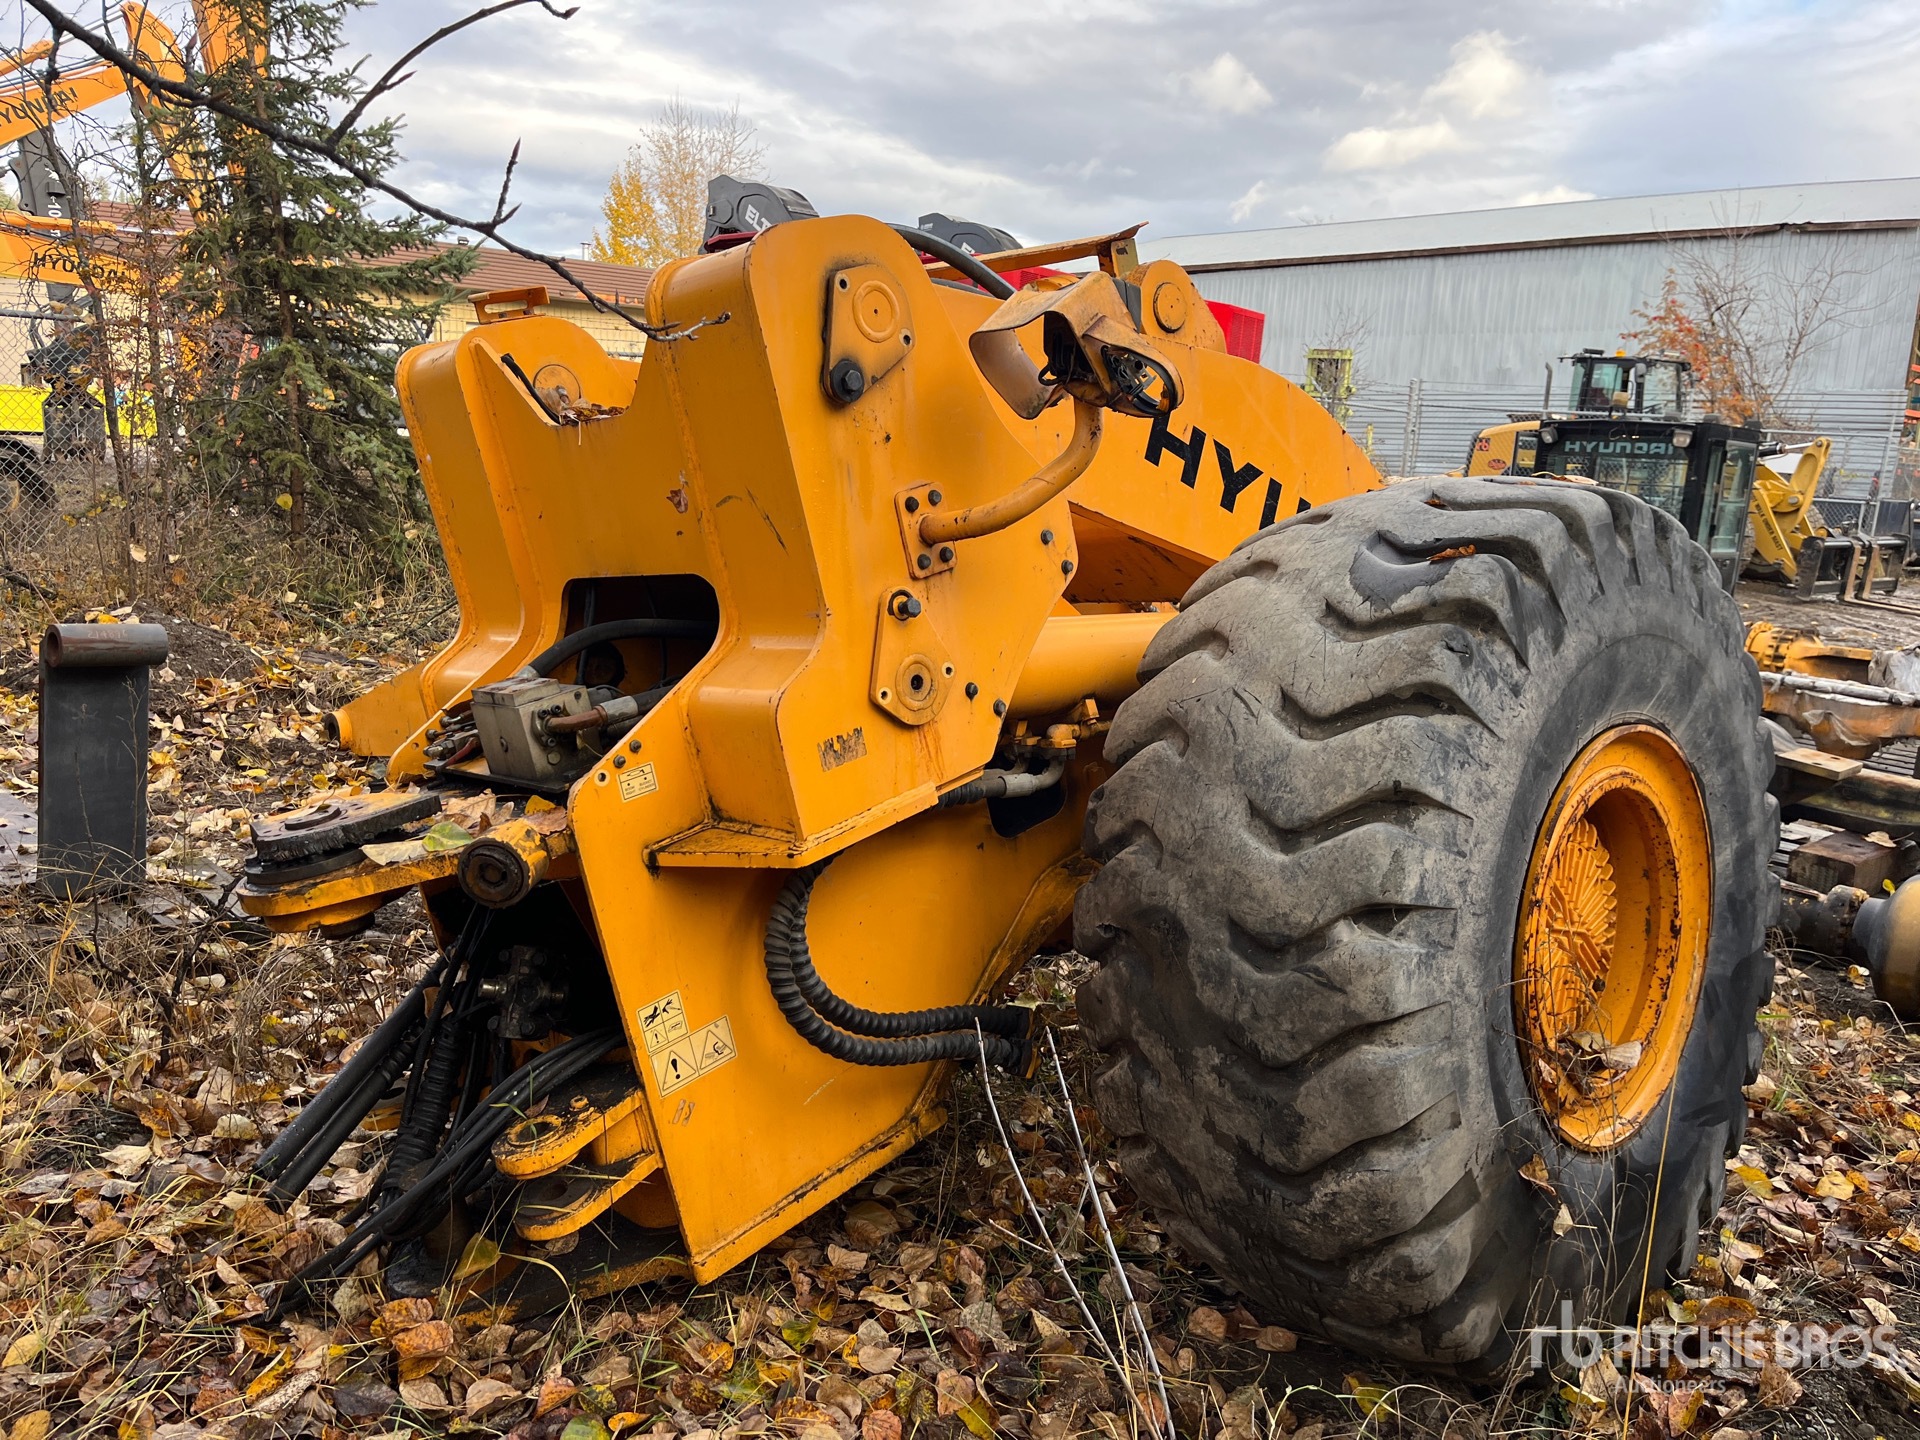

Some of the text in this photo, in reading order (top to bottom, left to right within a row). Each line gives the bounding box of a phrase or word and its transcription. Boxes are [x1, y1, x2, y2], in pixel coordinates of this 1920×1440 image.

[0, 87, 78, 126] YUNAI
[33, 252, 126, 279] HYUDAI
[1564, 441, 1674, 455] HYUNDAI
